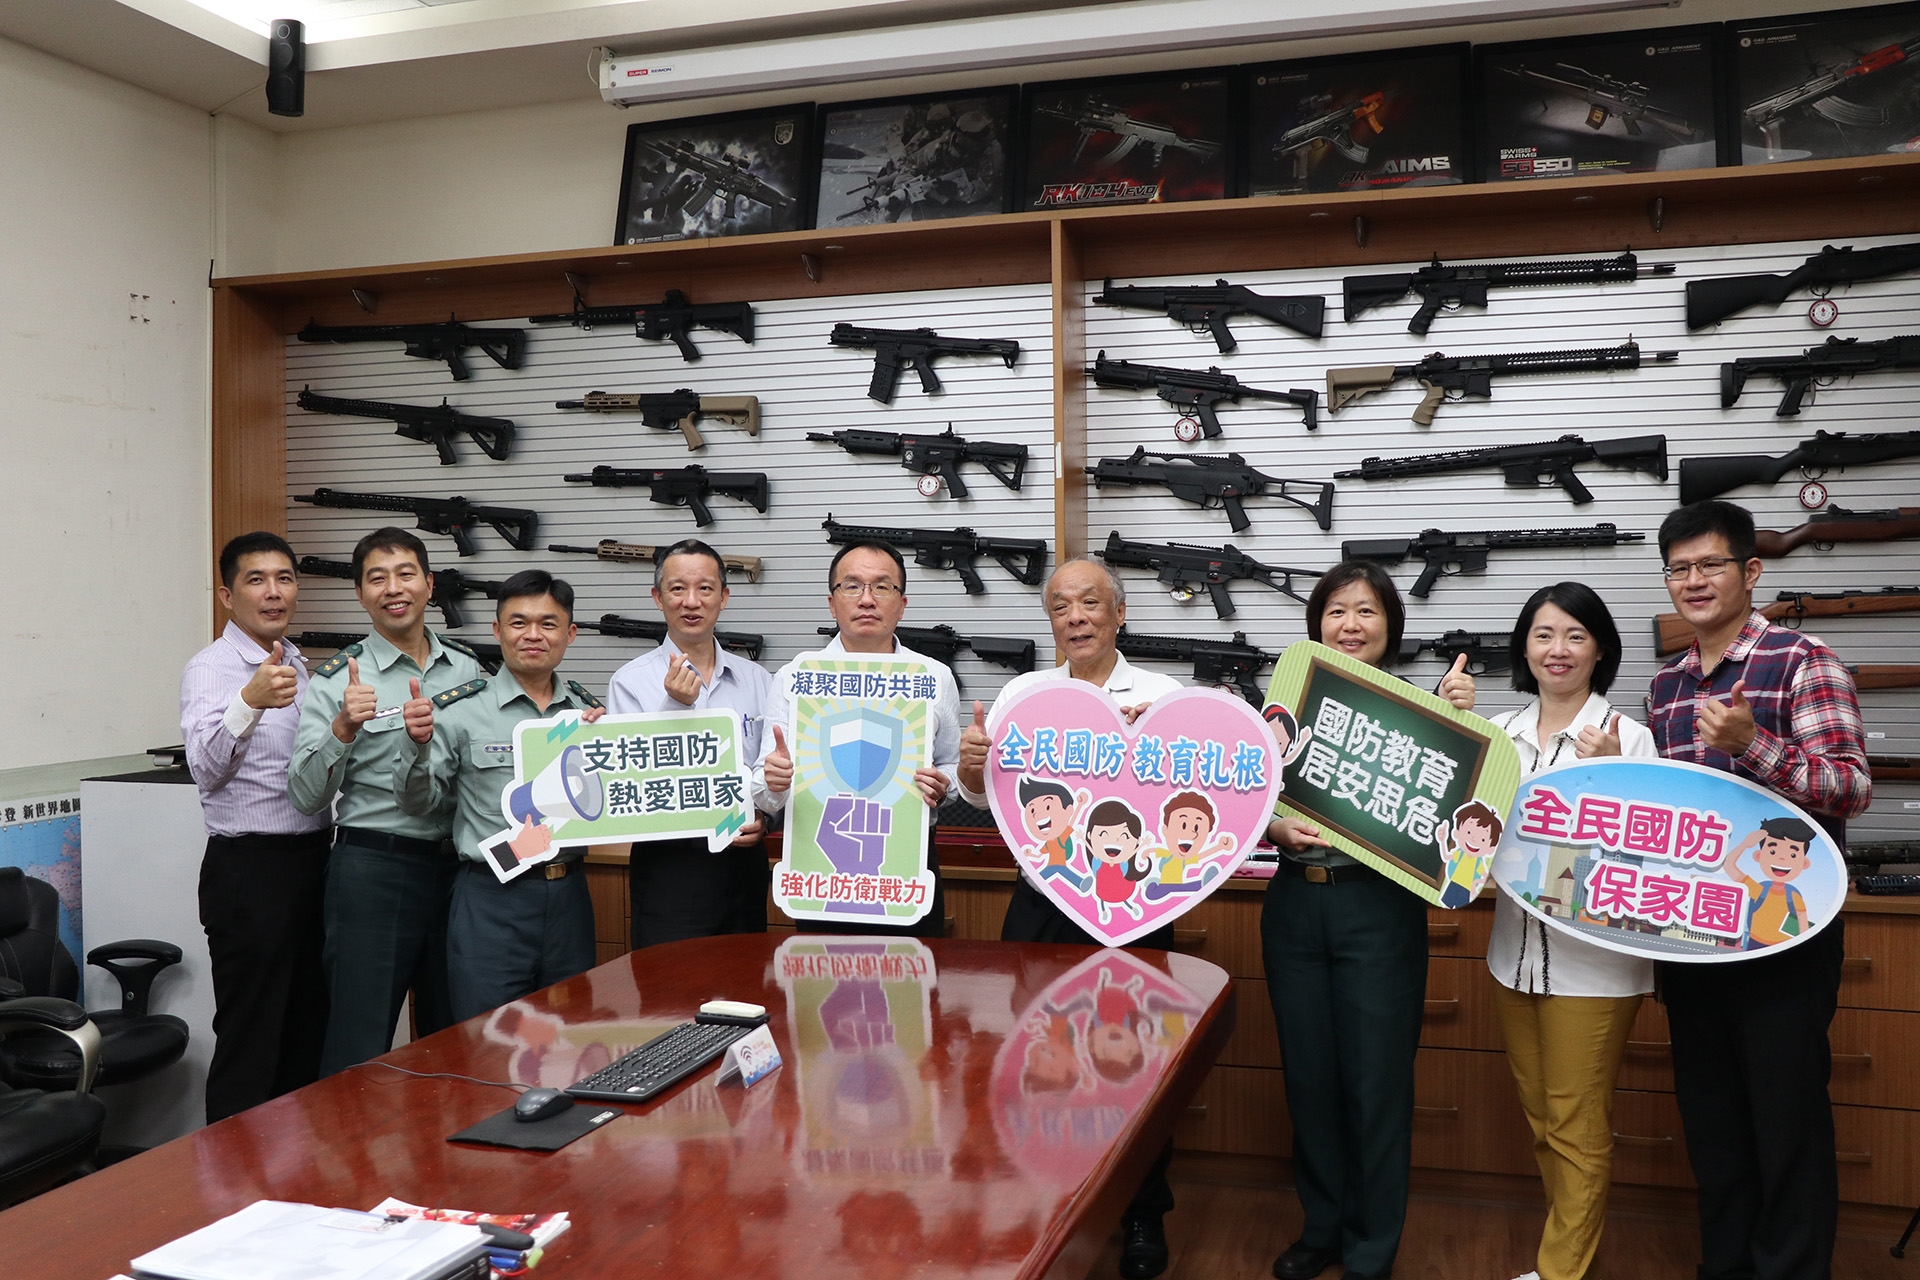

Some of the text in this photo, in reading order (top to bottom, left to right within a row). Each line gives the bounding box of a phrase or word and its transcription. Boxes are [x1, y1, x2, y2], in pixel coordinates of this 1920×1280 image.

[1381, 156, 1451, 174] AIMS
[790, 671, 937, 700] 凝聚國防共識
[583, 732, 718, 773] 支持國防
[1000, 723, 1265, 787] 全民國防 教育扎根
[1313, 696, 1458, 799] 國防教育
[609, 774, 745, 815] 熱愛國家
[1298, 740, 1440, 845] 居安思危
[0, 807, 16, 823] 登
[1521, 789, 1727, 863] 全民國防
[781, 872, 926, 904] 強化防衛戰力
[1590, 864, 1744, 934] 保家園
